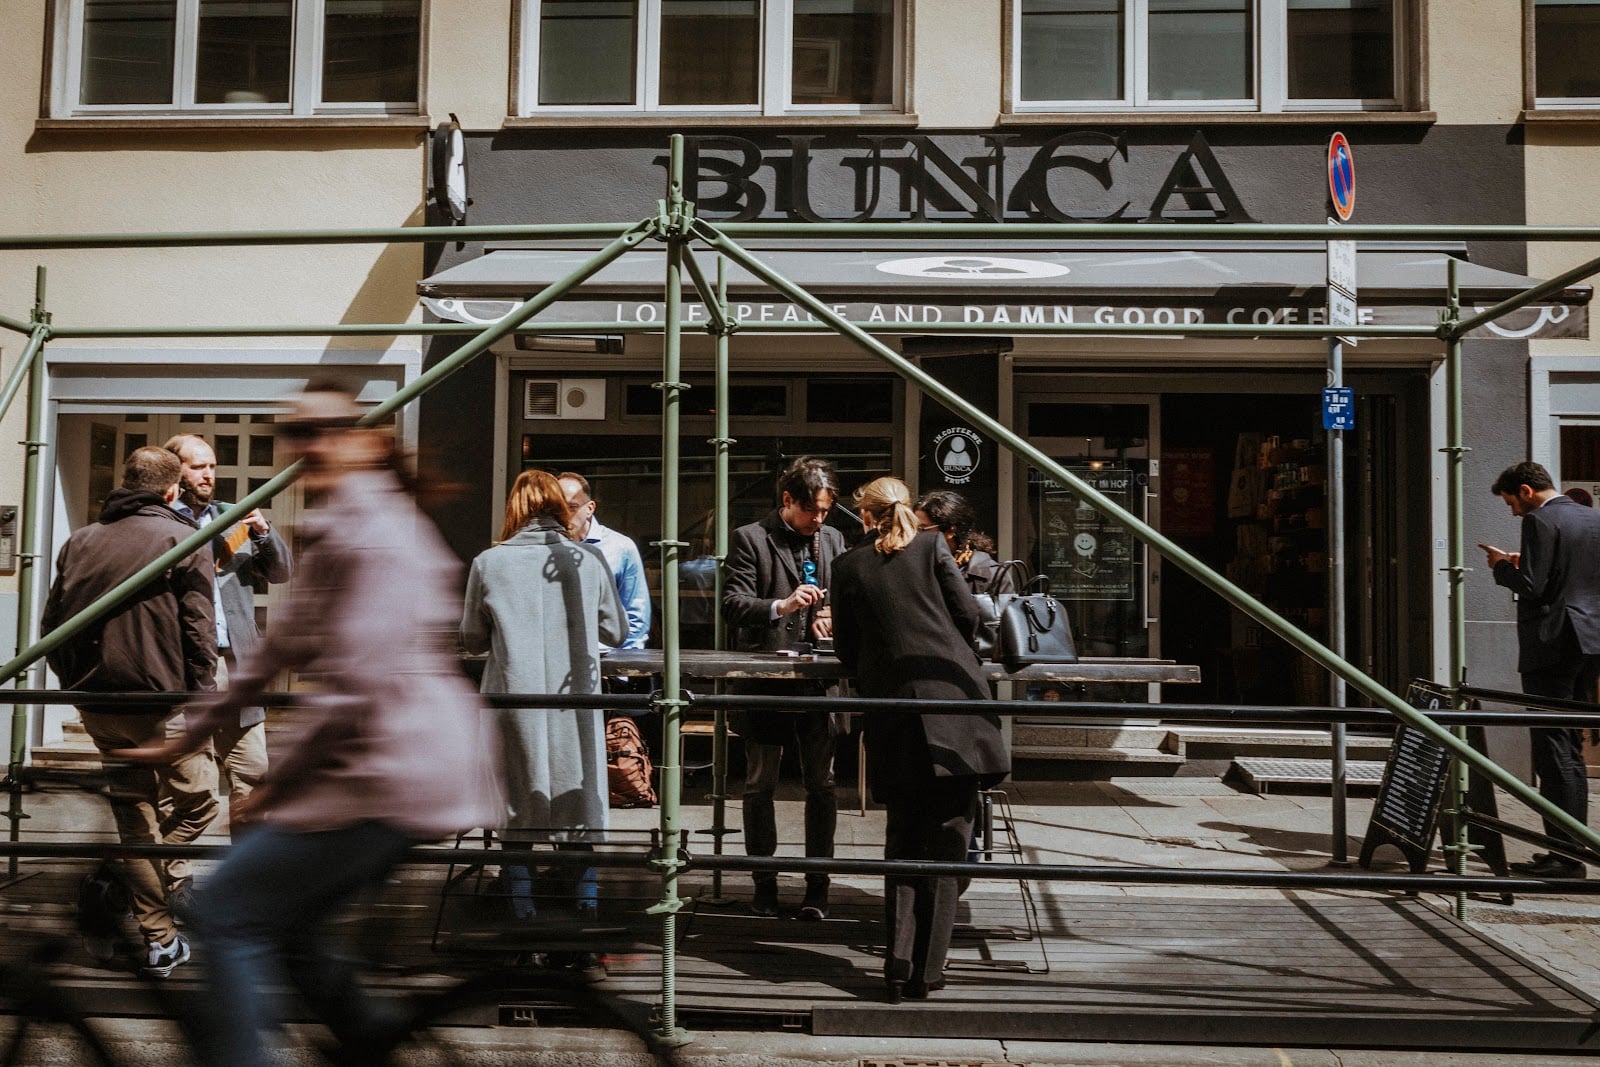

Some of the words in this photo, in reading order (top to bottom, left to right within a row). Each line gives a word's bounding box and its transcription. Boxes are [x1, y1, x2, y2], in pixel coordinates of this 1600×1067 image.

[670, 131, 1262, 225] BUNCA
[616, 304, 703, 322] LOE
[868, 304, 943, 323] AND
[963, 305, 1074, 324] DAMN
[1093, 307, 1205, 325] GOOD
[1226, 307, 1374, 325] COFFE
[944, 476, 970, 484] TRUST
[1110, 479, 1129, 489] HOF
